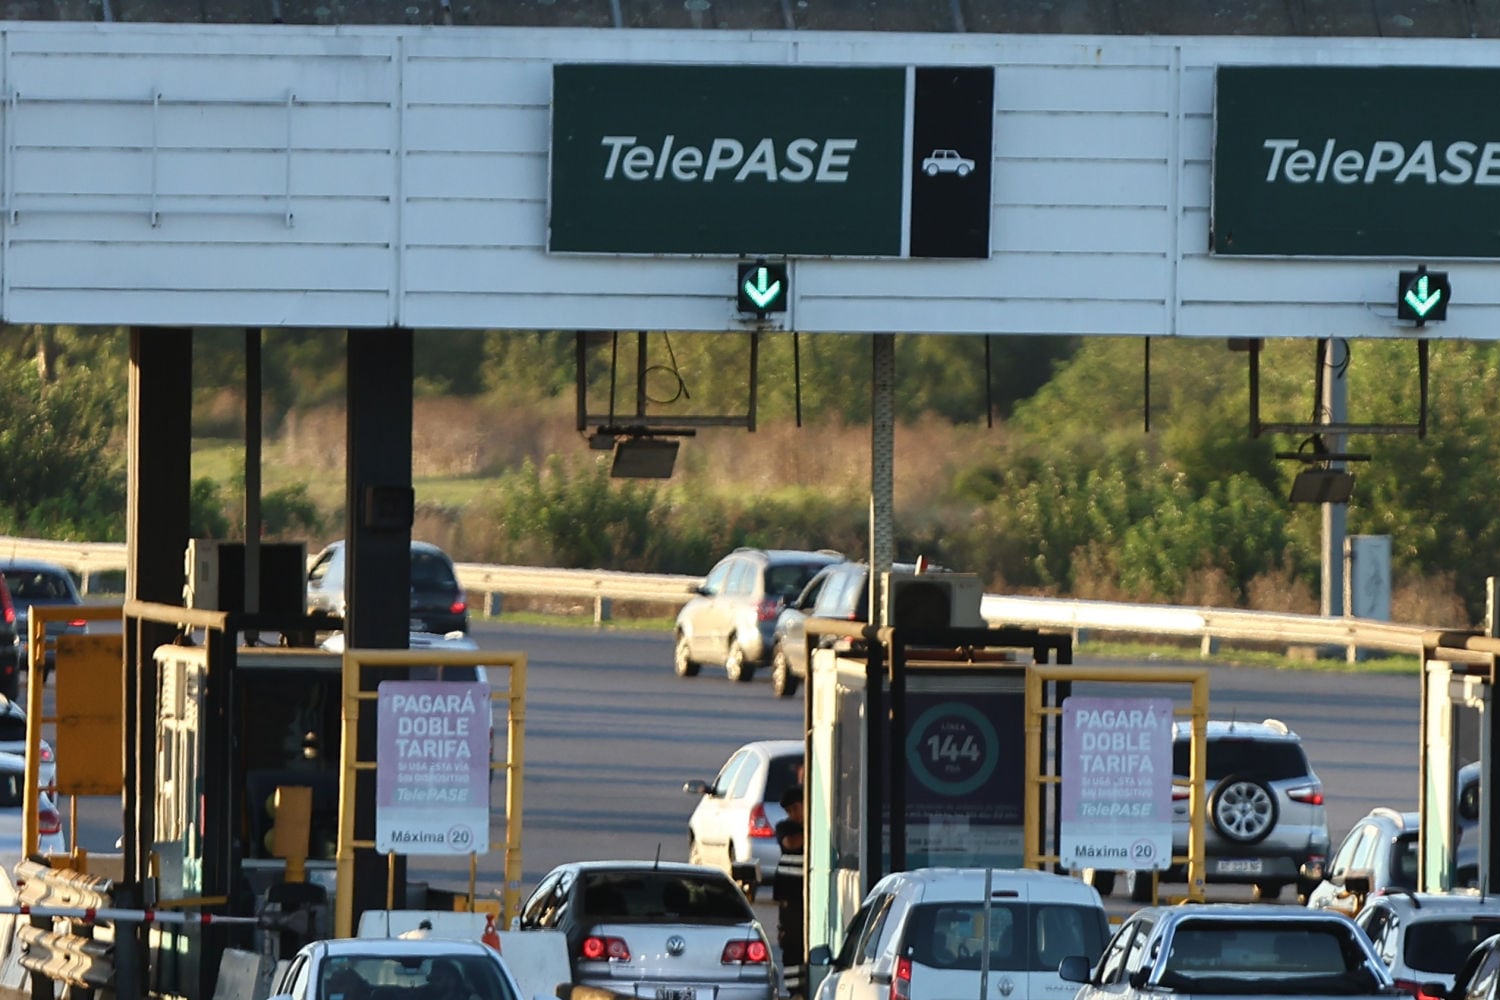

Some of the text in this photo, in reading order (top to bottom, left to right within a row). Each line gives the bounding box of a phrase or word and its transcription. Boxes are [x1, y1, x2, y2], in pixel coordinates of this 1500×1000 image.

[603, 135, 857, 182] TelePASE
[392, 689, 476, 713] PAGARÁ
[398, 717, 469, 735] DOBLE
[1076, 705, 1158, 729] PAGARÁ
[395, 739, 471, 758] TARIFA
[927, 735, 981, 762] 144
[1082, 732, 1151, 751] DOBLE
[1080, 754, 1154, 773] TARIFA
[397, 788, 469, 801] TelePASE
[1081, 803, 1153, 816] TelePASE
[391, 831, 470, 844] Máxima 20
[1075, 845, 1152, 858] Máxima 20
